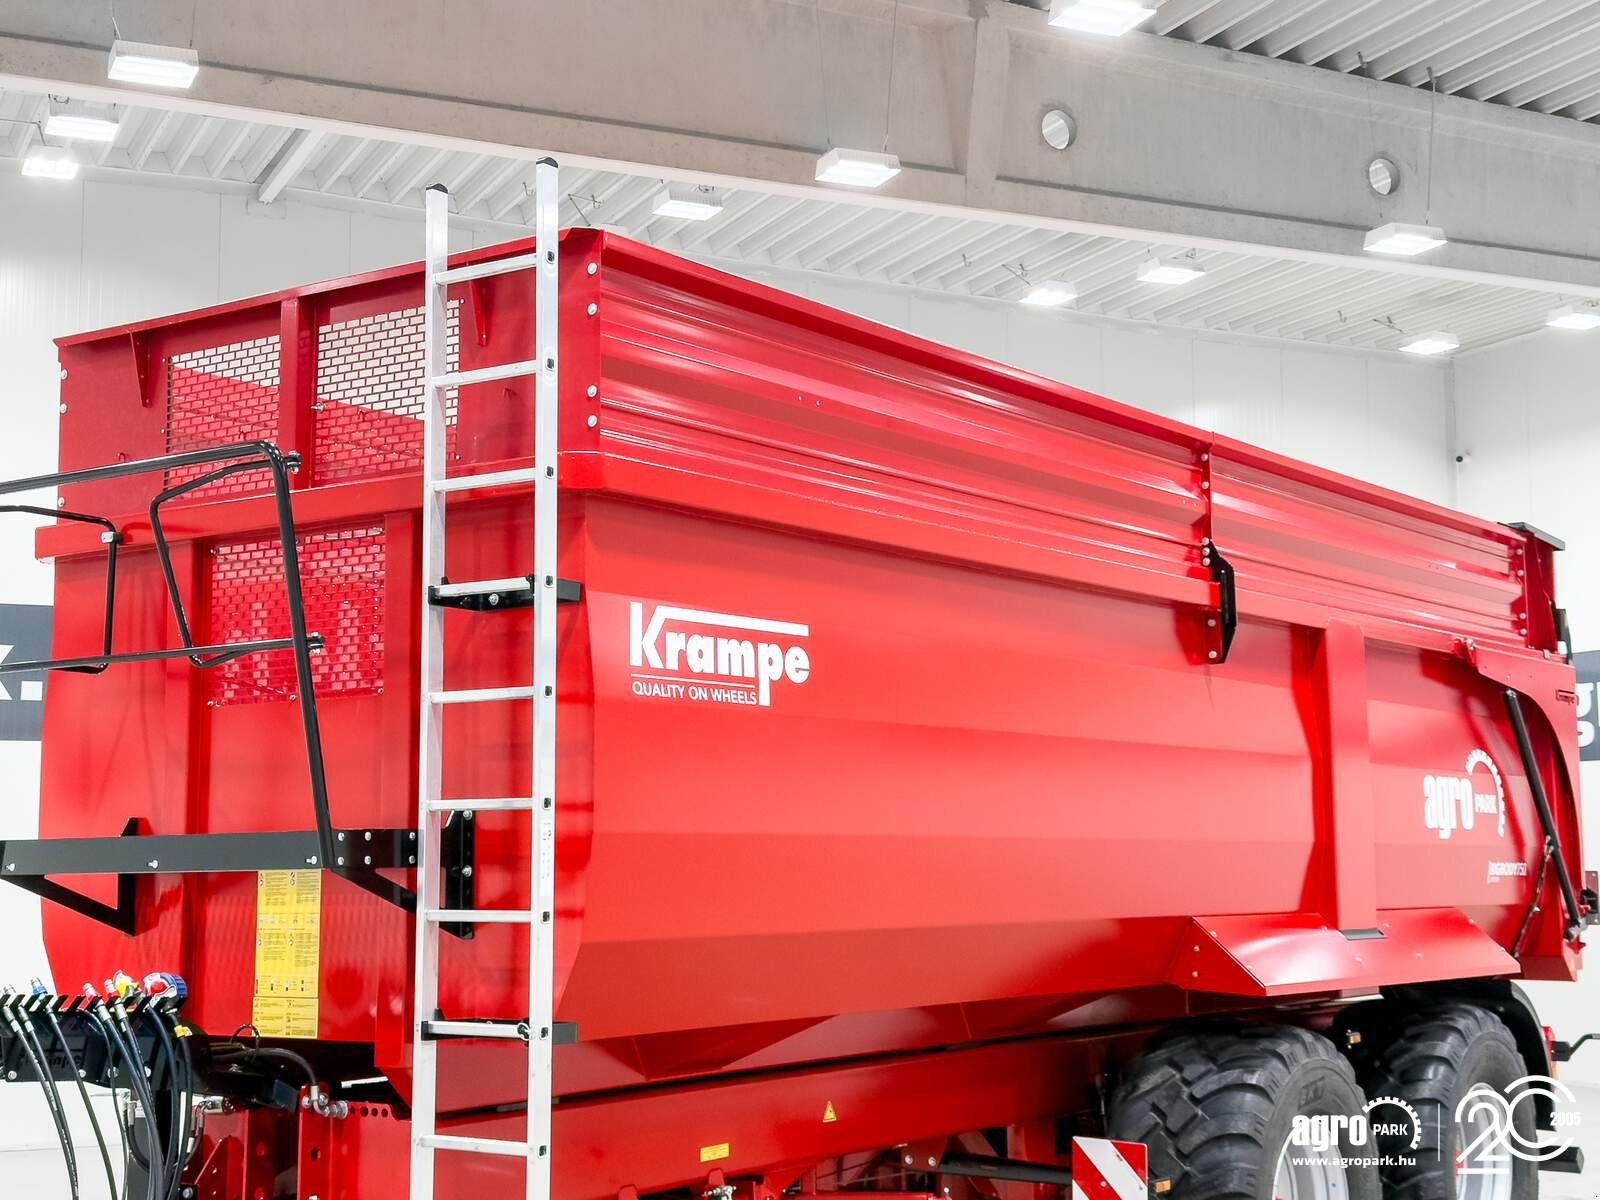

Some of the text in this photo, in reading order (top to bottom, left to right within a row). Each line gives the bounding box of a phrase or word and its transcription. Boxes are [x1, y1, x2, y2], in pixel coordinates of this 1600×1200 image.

[630, 601, 810, 707] Krampe
[631, 681, 757, 705] QUALITY ON WHEELS
[1424, 775, 1475, 839] agro
